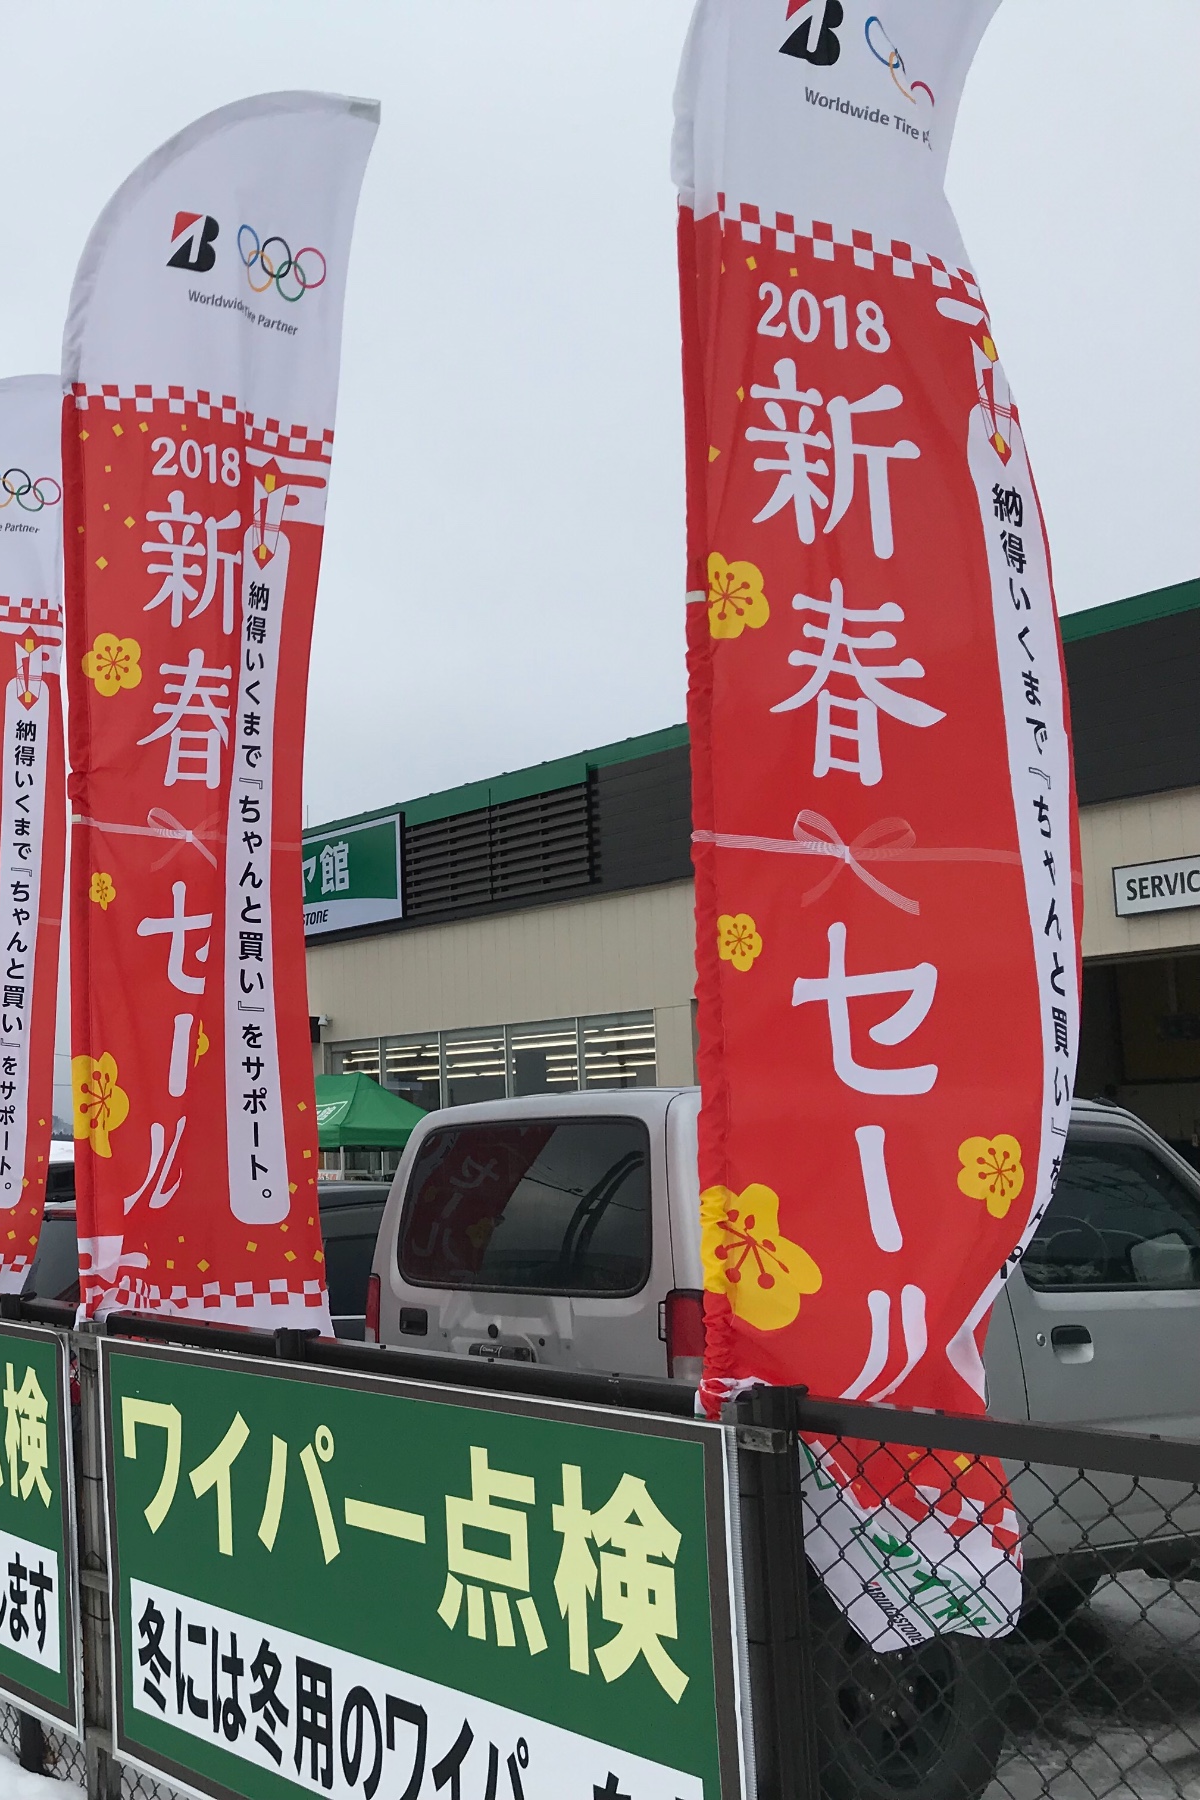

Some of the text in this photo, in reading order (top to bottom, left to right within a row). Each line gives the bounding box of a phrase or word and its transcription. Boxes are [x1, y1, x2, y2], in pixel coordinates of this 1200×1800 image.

[804, 86, 920, 140] Worldwide Tire
[257, 314, 299, 336] Partner
[756, 281, 892, 354] 2018
[150, 436, 241, 487] 2018
[4, 522, 40, 535] Partner
[121, 1395, 690, 1705] ワイパー点検
